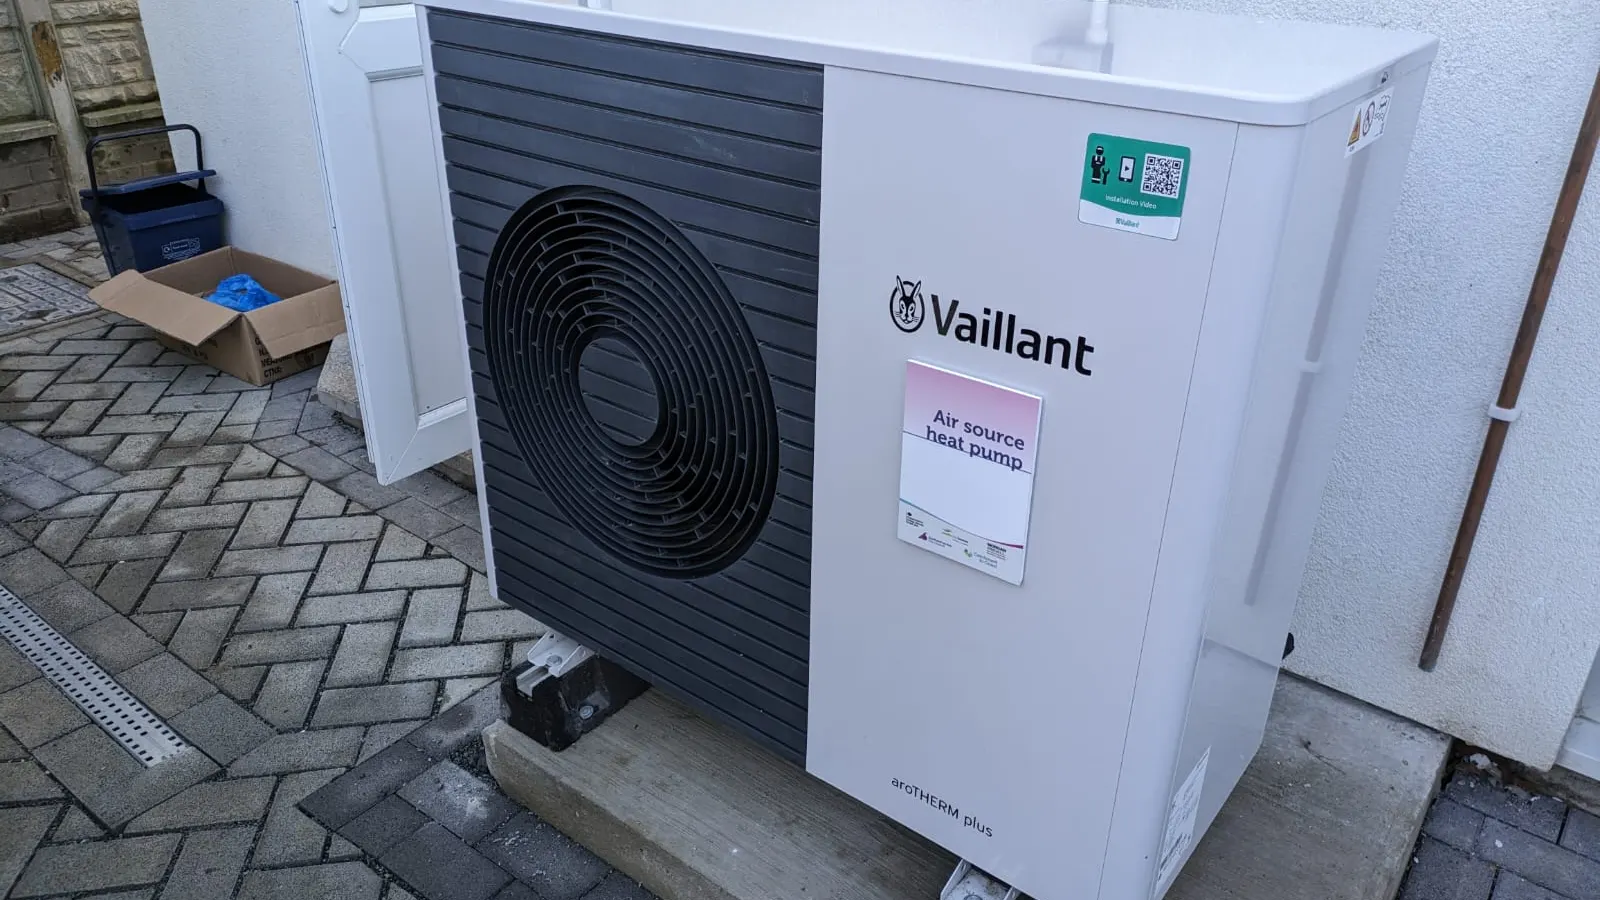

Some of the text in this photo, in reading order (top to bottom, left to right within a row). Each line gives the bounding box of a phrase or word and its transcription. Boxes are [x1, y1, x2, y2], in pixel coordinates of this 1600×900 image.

[1105, 193, 1157, 210] Installation Video
[930, 293, 1095, 377] Vaillant
[926, 425, 1023, 472] heat pump
[933, 409, 1025, 451] Air source
[891, 777, 993, 838] aroTHERM plus
